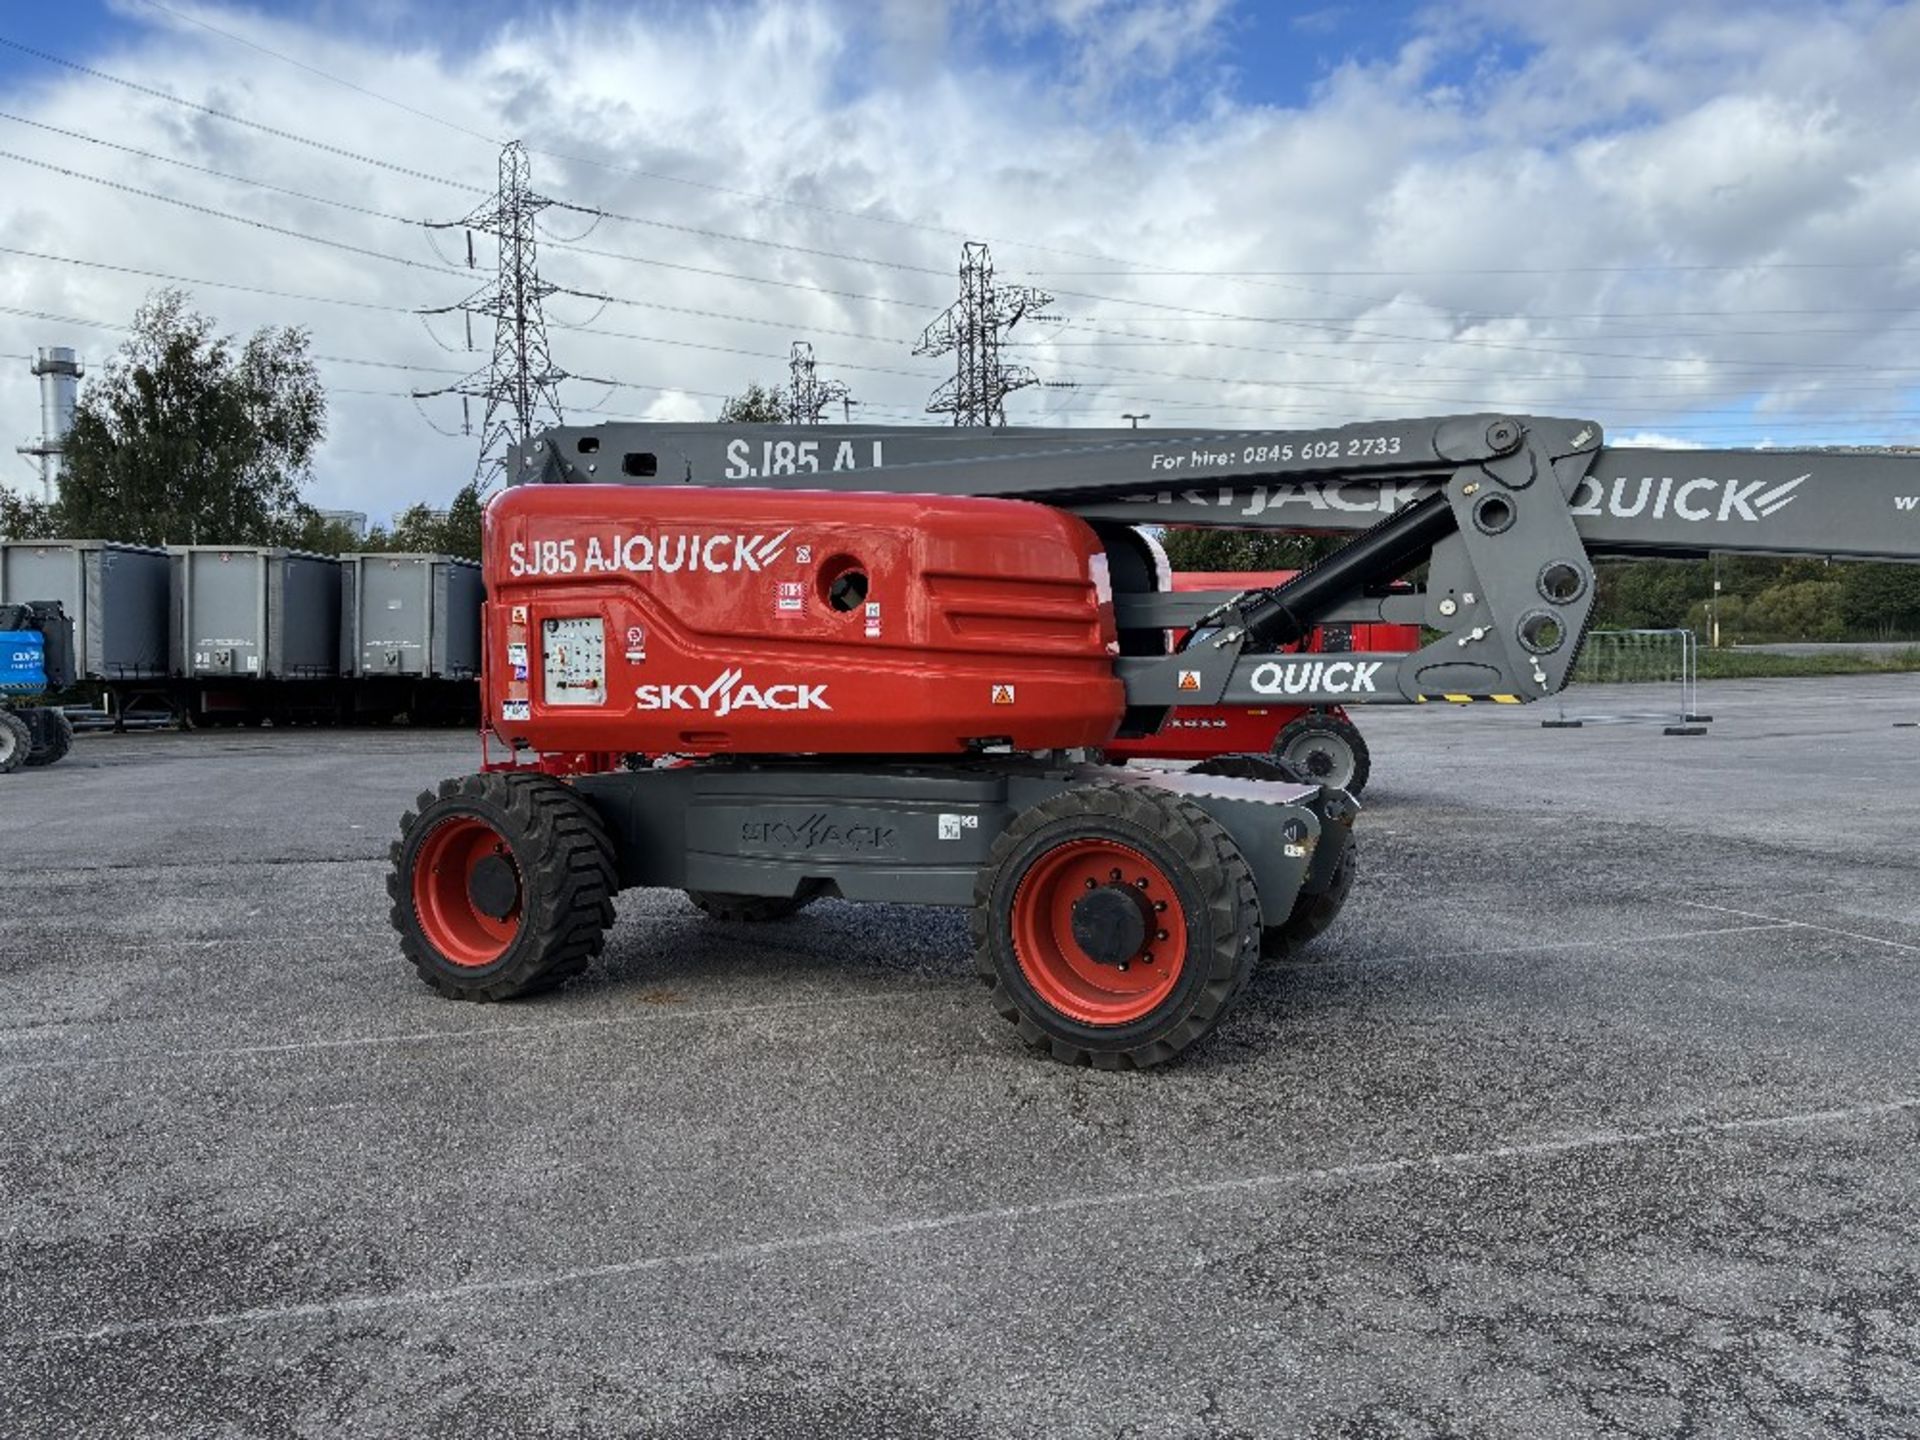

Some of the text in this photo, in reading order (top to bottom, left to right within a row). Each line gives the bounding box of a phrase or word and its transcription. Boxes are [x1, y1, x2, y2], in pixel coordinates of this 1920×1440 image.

[1151, 437, 1401, 469] For hire: 0845 602 2733
[510, 536, 622, 577] SJ85 AJ
[621, 534, 766, 573] QUICK
[635, 668, 832, 716] SKYJACK
[1251, 661, 1383, 693] QUICK
